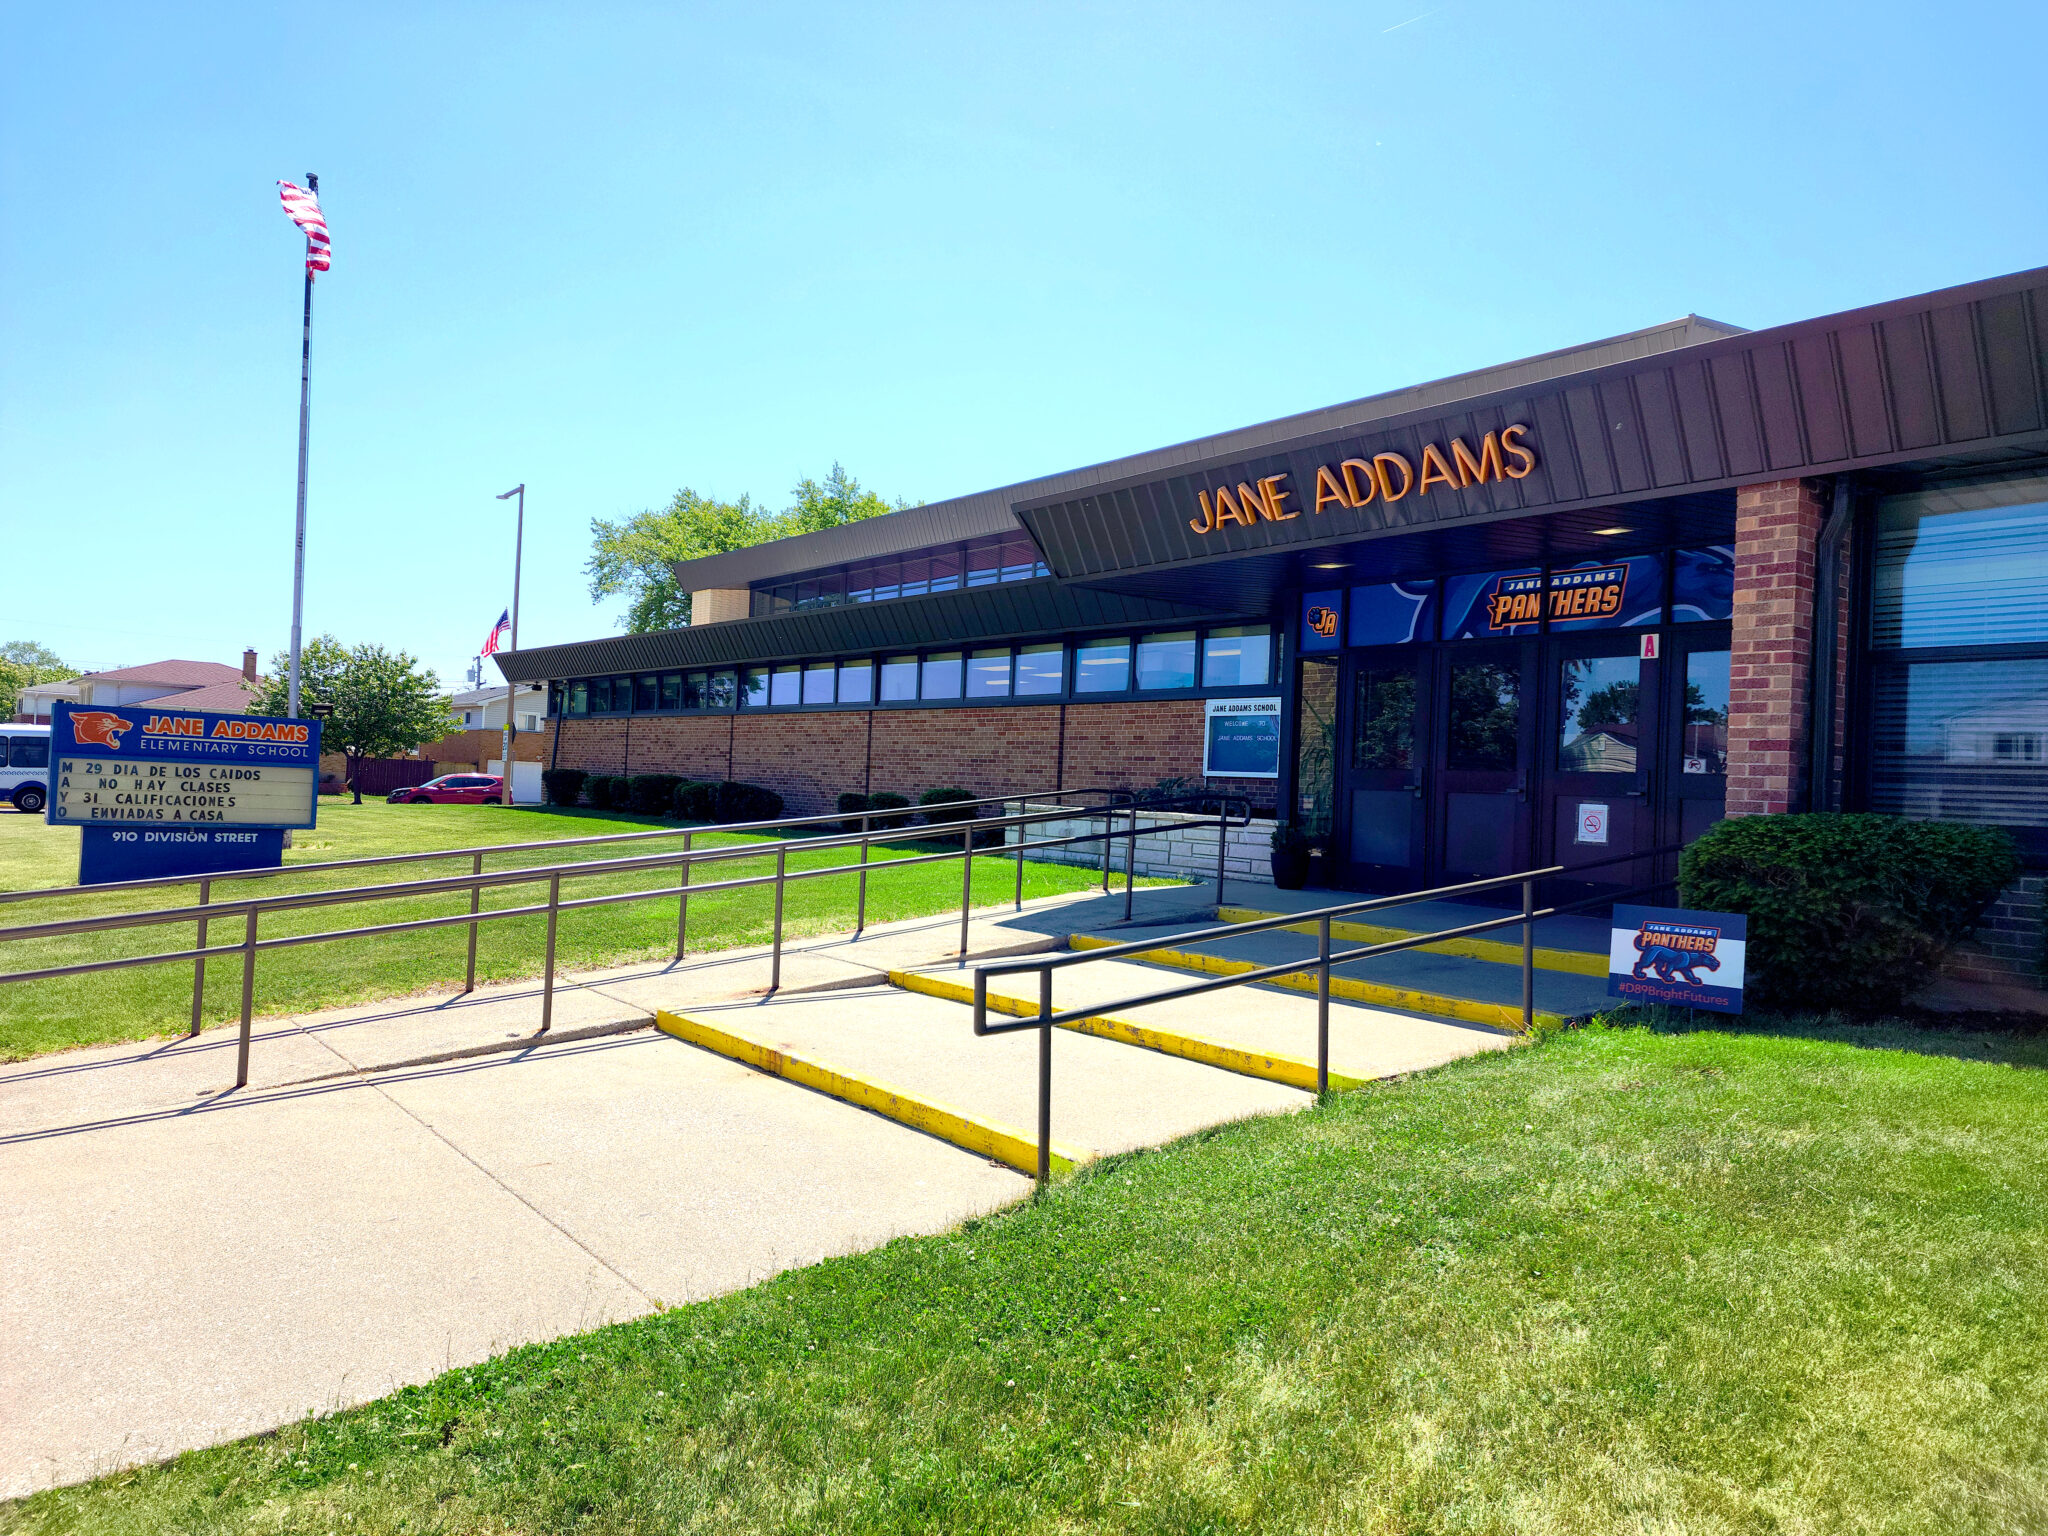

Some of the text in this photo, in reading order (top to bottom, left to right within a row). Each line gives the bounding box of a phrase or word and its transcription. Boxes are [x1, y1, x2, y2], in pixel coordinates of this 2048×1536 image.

[1190, 424, 1536, 534] JANE ADDAMS
[1551, 571, 1616, 586] ADDAMS
[1315, 609, 1336, 634] JA
[1644, 635, 1655, 657] A
[1254, 704, 1277, 712] SCHOOL
[143, 715, 309, 743] JANE ADDAMS
[140, 739, 309, 758] ELEMENTARY SCHOOL
[85, 762, 261, 781] 29 DIA DE LOS CAIDOS
[98, 778, 231, 793] NO HAY CLASES
[83, 792, 236, 808] 31 CALIFICACIONES
[91, 807, 224, 821] ENVIADAS A CASA
[112, 831, 259, 843] 910 DIVISION STREET
[1673, 927, 1713, 936] ADDAMS
[1641, 932, 1716, 951] PANTHERS
[1618, 982, 1729, 1006] #D89BrightFutures
